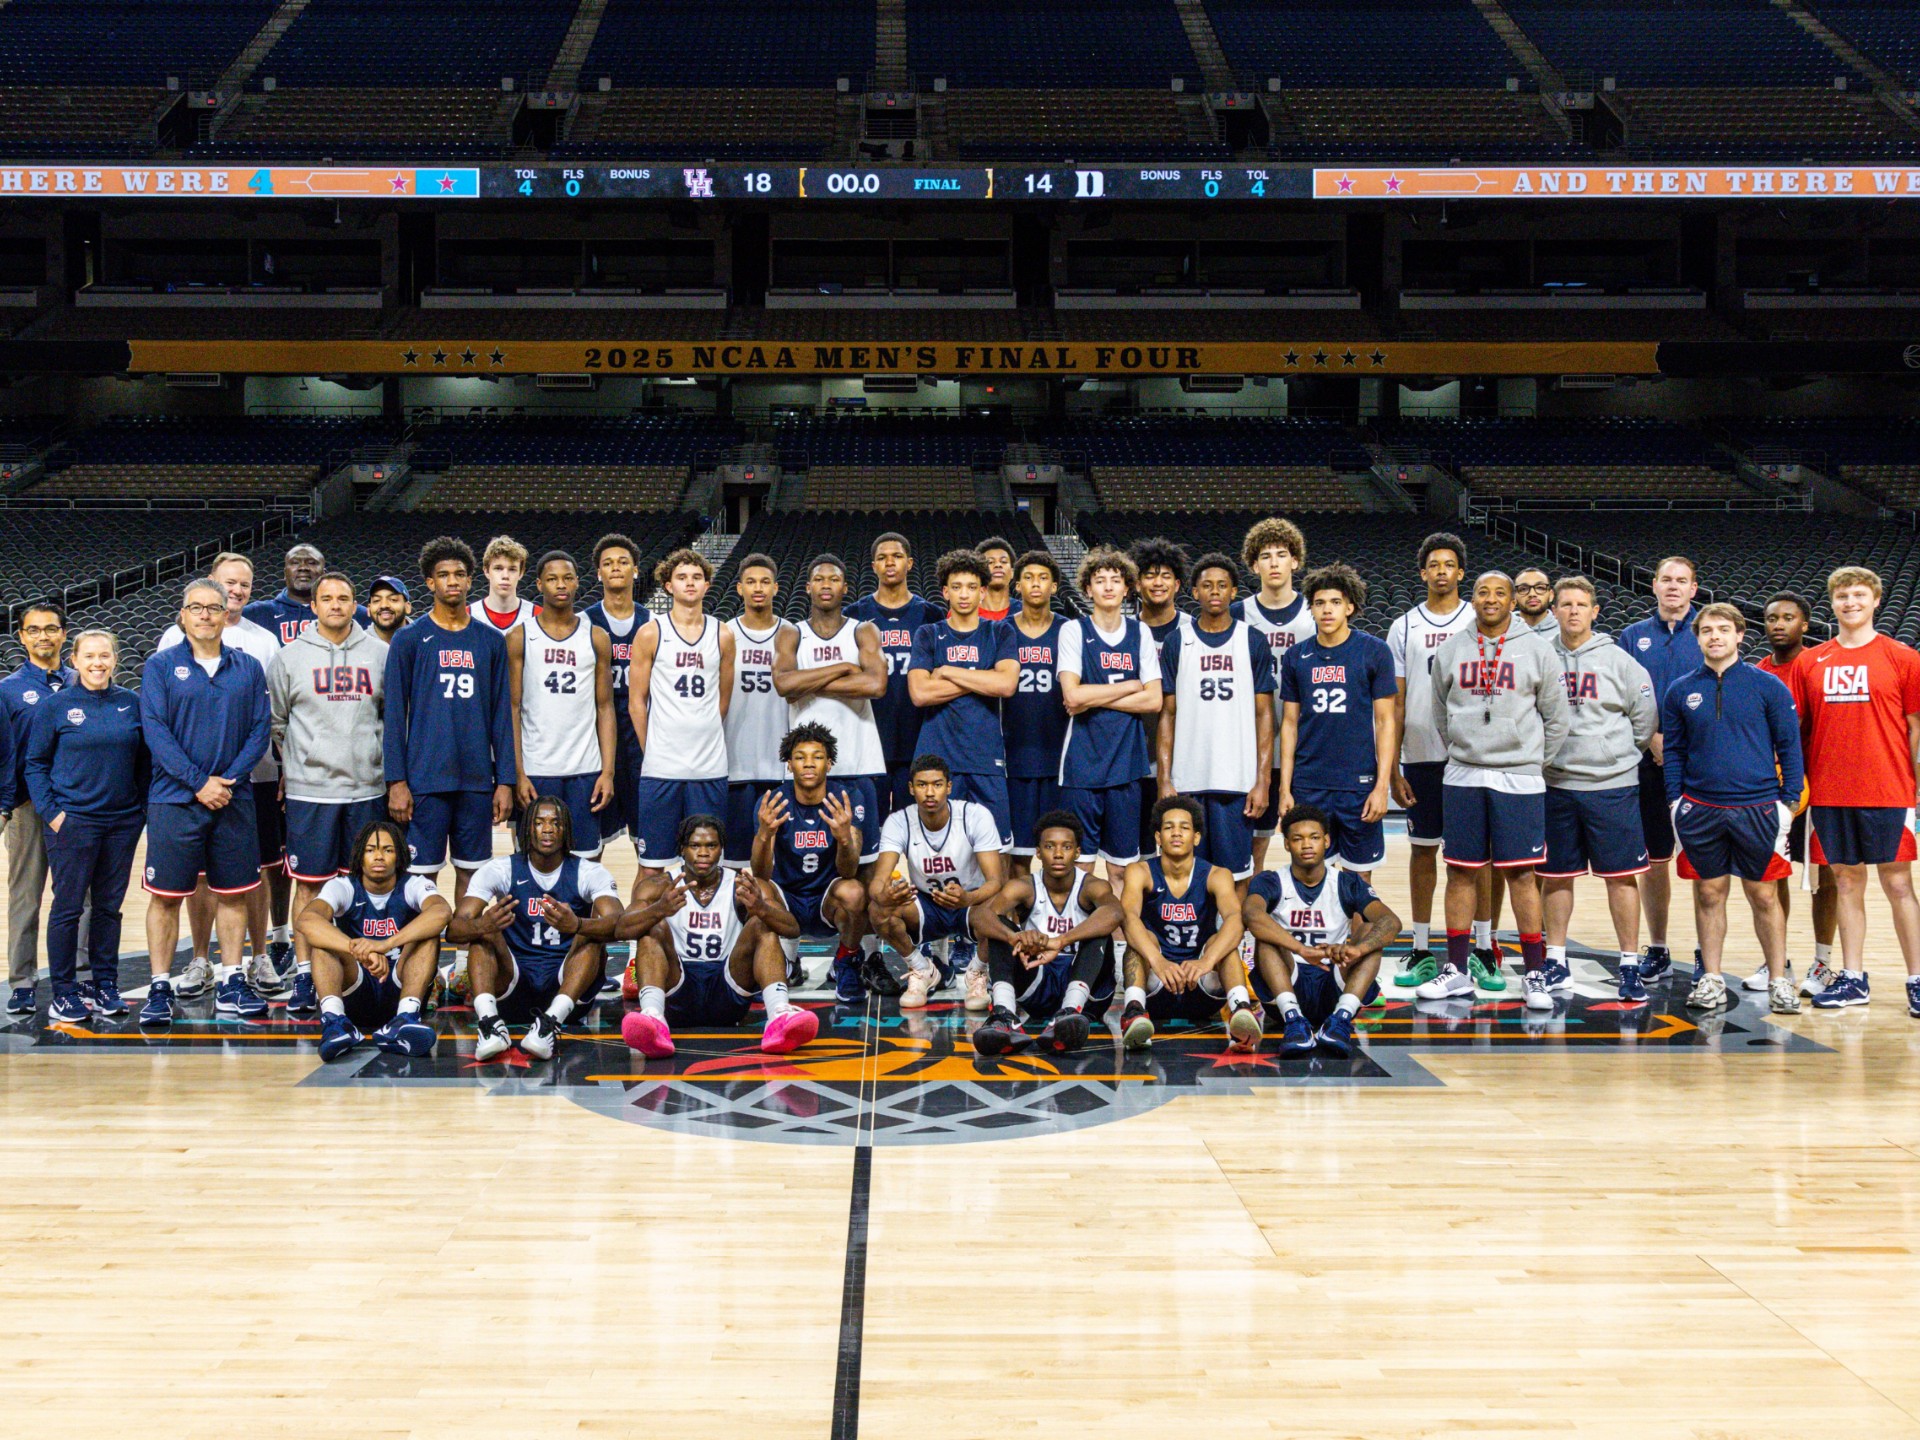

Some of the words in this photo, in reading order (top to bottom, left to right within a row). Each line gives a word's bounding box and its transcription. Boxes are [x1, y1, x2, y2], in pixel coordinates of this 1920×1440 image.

[1, 171, 102, 191] HERE
[122, 171, 229, 192] WERE
[248, 169, 273, 195] 4
[515, 169, 537, 179] TOL
[563, 169, 584, 179] FLS
[610, 169, 650, 179] BONUS
[743, 173, 772, 193] 18
[827, 173, 880, 193] 00.0
[1025, 173, 1053, 193] 14
[1140, 171, 1181, 180] BONUS
[1201, 171, 1223, 180] FLS
[1247, 171, 1269, 180] TOL
[1512, 172, 1588, 193] AND
[1606, 172, 1708, 193] THEN
[1726, 172, 1854, 193] THERE
[518, 180, 533, 196] 4
[565, 180, 580, 197] 0
[914, 179, 961, 190] FINAL
[1204, 181, 1219, 197] 0
[1252, 181, 1265, 197] 4
[584, 347, 675, 369] 2025
[692, 346, 797, 369] NCAA
[814, 346, 937, 369] MEN'S
[955, 347, 1077, 369] FINAL
[1095, 347, 1202, 369] FOUR
[880, 630, 912, 648] USA
[439, 650, 475, 669] USA
[544, 648, 577, 667] USA
[676, 651, 706, 669] USA
[742, 649, 772, 666] USA
[813, 645, 843, 662] USA
[947, 645, 979, 663] USA
[1018, 646, 1053, 665] USA
[1100, 651, 1134, 671] USA
[1200, 653, 1234, 672] USA
[312, 665, 374, 696] USA
[544, 671, 577, 694] 42
[740, 670, 772, 694] 55
[1018, 669, 1053, 693] 29
[1312, 666, 1346, 684] USA
[1823, 665, 1870, 695] USA
[439, 673, 475, 699] 79
[674, 674, 706, 698] 48
[1199, 677, 1234, 701] 85
[1312, 688, 1347, 713] 32
[795, 830, 828, 849] USA
[802, 853, 819, 874] 8
[923, 856, 957, 874] USA
[688, 911, 722, 929] USA
[1160, 903, 1196, 922] USA
[1290, 909, 1327, 928] USA
[363, 918, 400, 937] USA
[531, 921, 562, 946] 14
[1163, 925, 1198, 948] 37
[686, 932, 722, 958] 58
